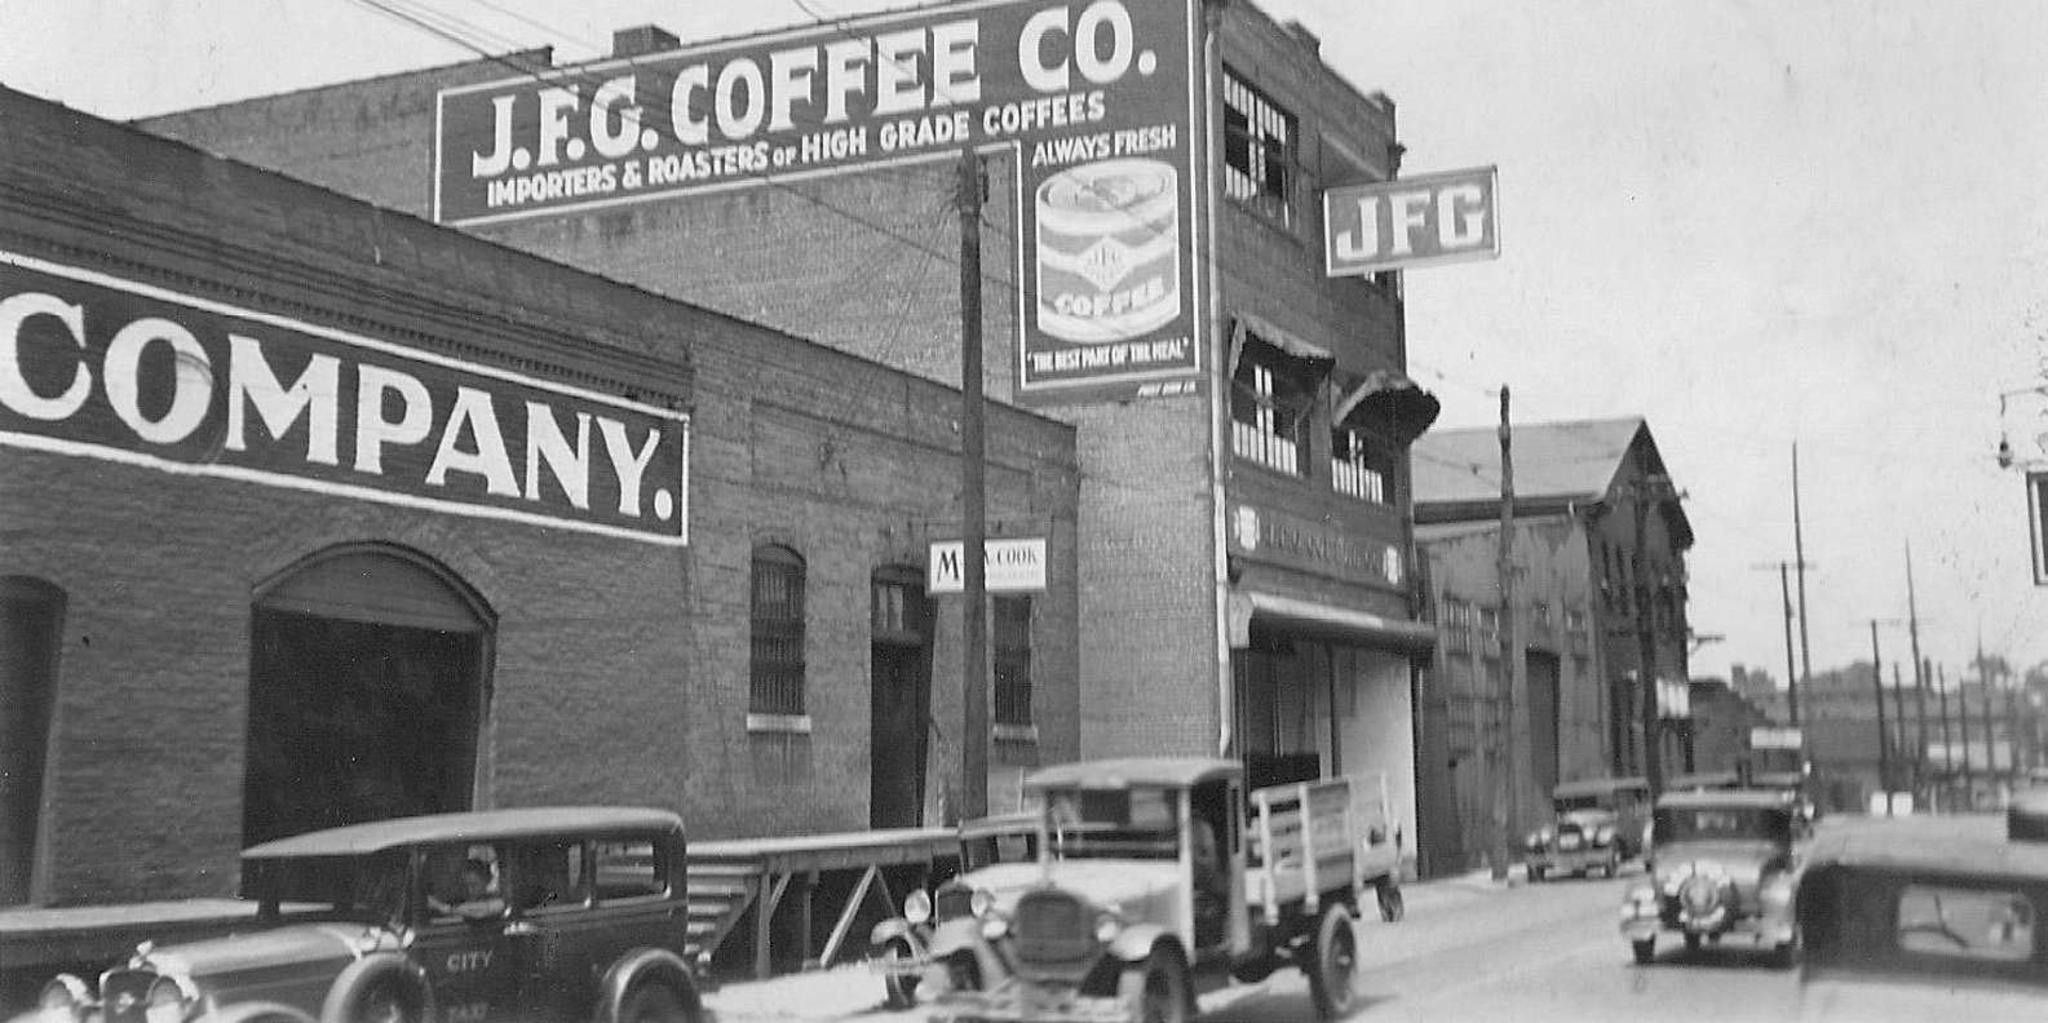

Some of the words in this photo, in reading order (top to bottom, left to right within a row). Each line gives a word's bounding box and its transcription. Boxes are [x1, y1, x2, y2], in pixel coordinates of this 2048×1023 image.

[473, 75, 659, 178] J.F.G.
[671, 19, 980, 146] COFFEE
[1018, 0, 1157, 92] CO.
[487, 163, 617, 208] IMPORTERS
[622, 161, 643, 189] &
[649, 141, 769, 184] ROASTERS
[802, 126, 867, 164] HIGH
[880, 112, 970, 152] GRADE
[983, 91, 1106, 136] COFFEES
[1032, 131, 1111, 167] ALWAYS
[1114, 124, 1177, 155] FRESH
[1336, 185, 1486, 261] JFG
[1054, 276, 1165, 317] COFFEE
[1055, 347, 1080, 372] BEST
[1081, 345, 1110, 369] PART
[1111, 343, 1129, 367] OF
[0, 292, 673, 522] COMPANY.
[446, 950, 494, 971] CITY
